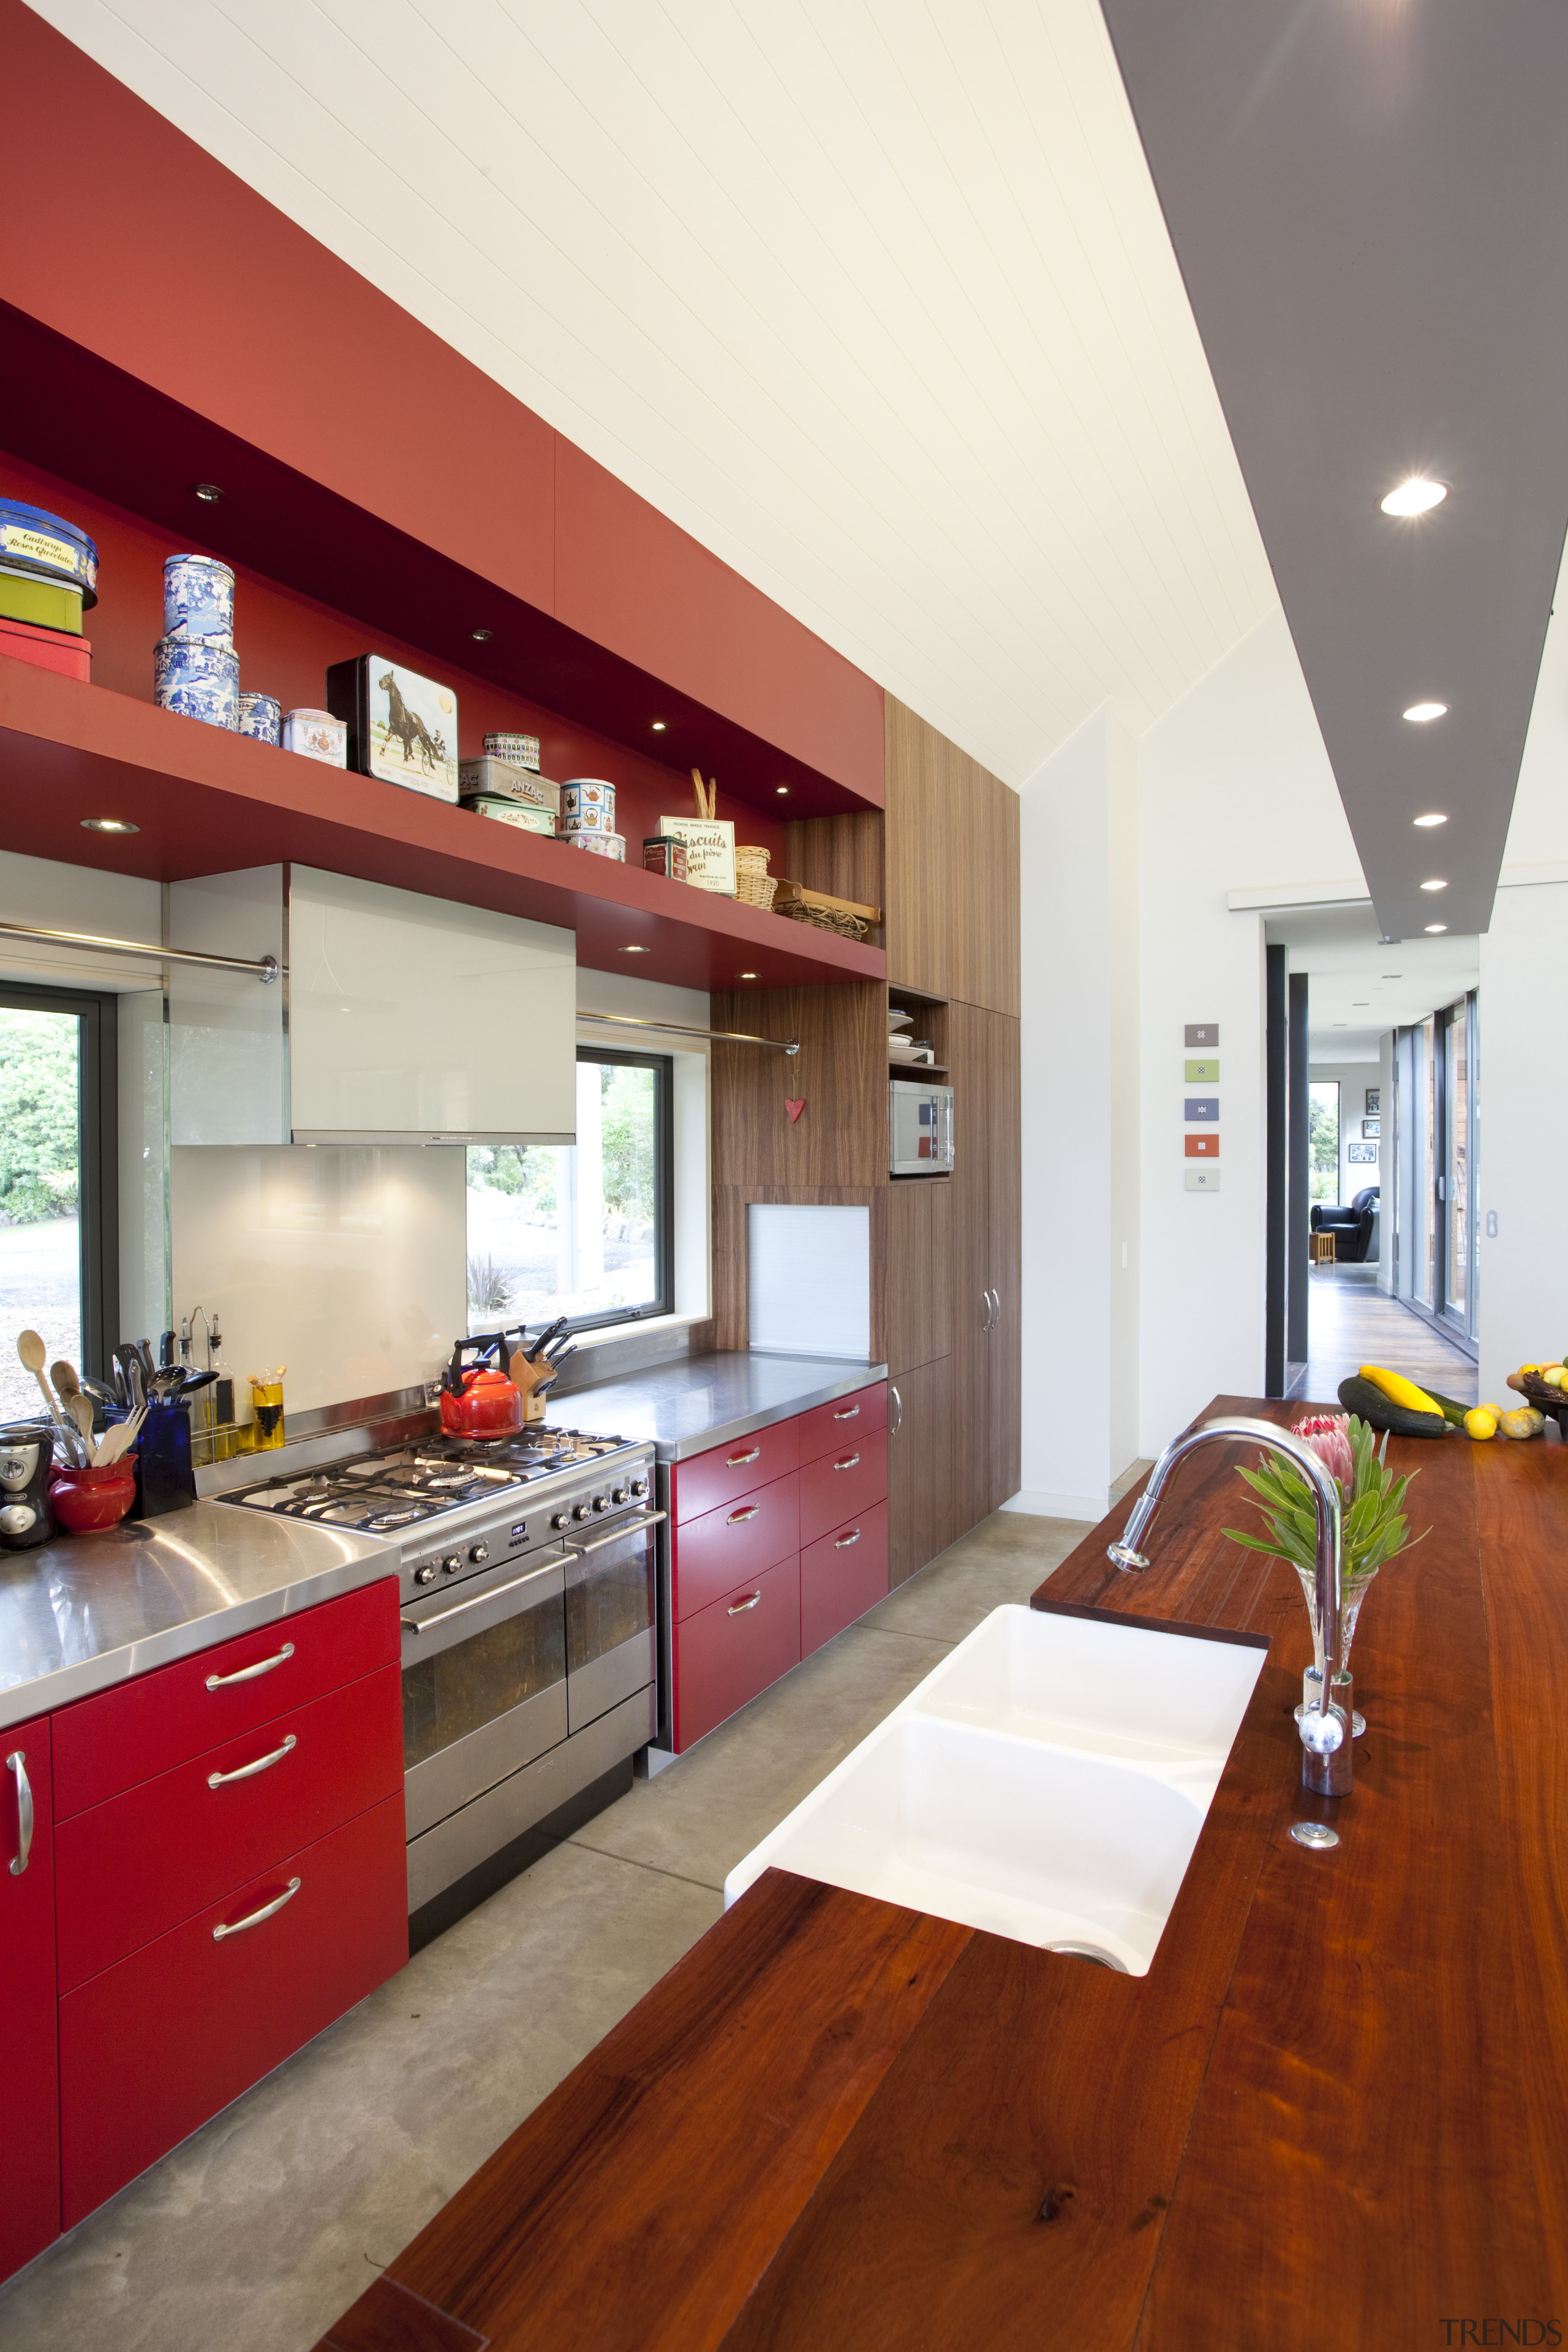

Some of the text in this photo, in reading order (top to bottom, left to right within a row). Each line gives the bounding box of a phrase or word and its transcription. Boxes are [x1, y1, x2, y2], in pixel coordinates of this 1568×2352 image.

[7, 538, 73, 565] Roses Chocolates
[511, 780, 543, 803] ANZAC
[690, 850, 701, 859] du
[703, 848, 722, 860] père
